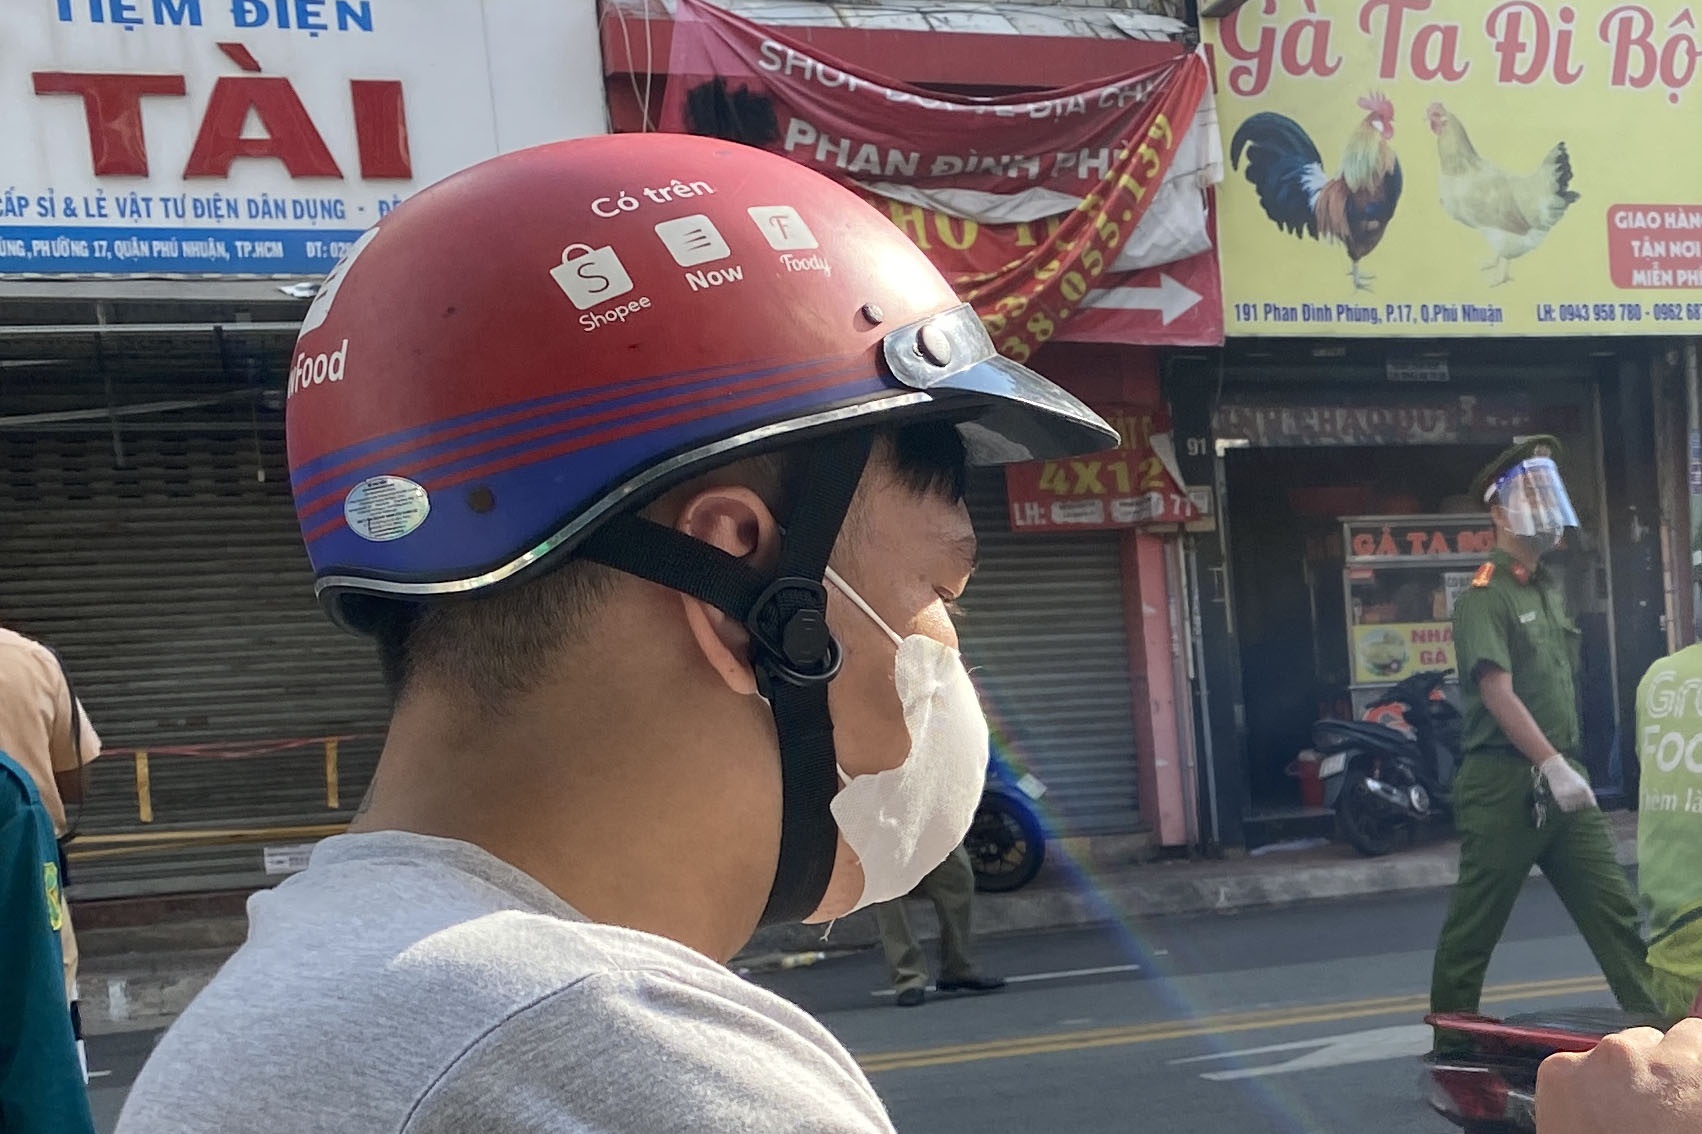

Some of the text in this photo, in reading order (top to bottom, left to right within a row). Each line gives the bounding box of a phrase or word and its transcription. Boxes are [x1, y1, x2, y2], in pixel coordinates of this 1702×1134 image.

[1219, 0, 1343, 97] Gà
[1358, 0, 1470, 82] Ta
[1485, 0, 1585, 85] Đi
[32, 43, 413, 179] TÀI
[784, 117, 1128, 180] PHAN ĐÌNH PH
[0, 186, 29, 217] ẤP
[63, 197, 78, 218] &
[115, 191, 153, 223] VẬT
[162, 193, 187, 219] TƯ
[193, 191, 243, 224] ĐIỆN
[248, 193, 286, 219] DÂN
[293, 198, 346, 225] DỤNG
[591, 177, 716, 219] Có trên
[1614, 211, 1661, 229] GIAO
[114, 235, 148, 262] QUẬN
[1631, 236, 1702, 261] TẬN NƠI
[684, 263, 745, 293] Now
[780, 252, 832, 278] Foody
[1632, 262, 1672, 287] MIỄN
[577, 296, 652, 334] Shopee
[1235, 303, 1258, 322] 191
[1264, 303, 1297, 322] Phan
[1302, 302, 1332, 322] Đình
[1462, 302, 1504, 326] Nhuận
[1537, 303, 1556, 322] LH:
[1559, 303, 1590, 322] 0943
